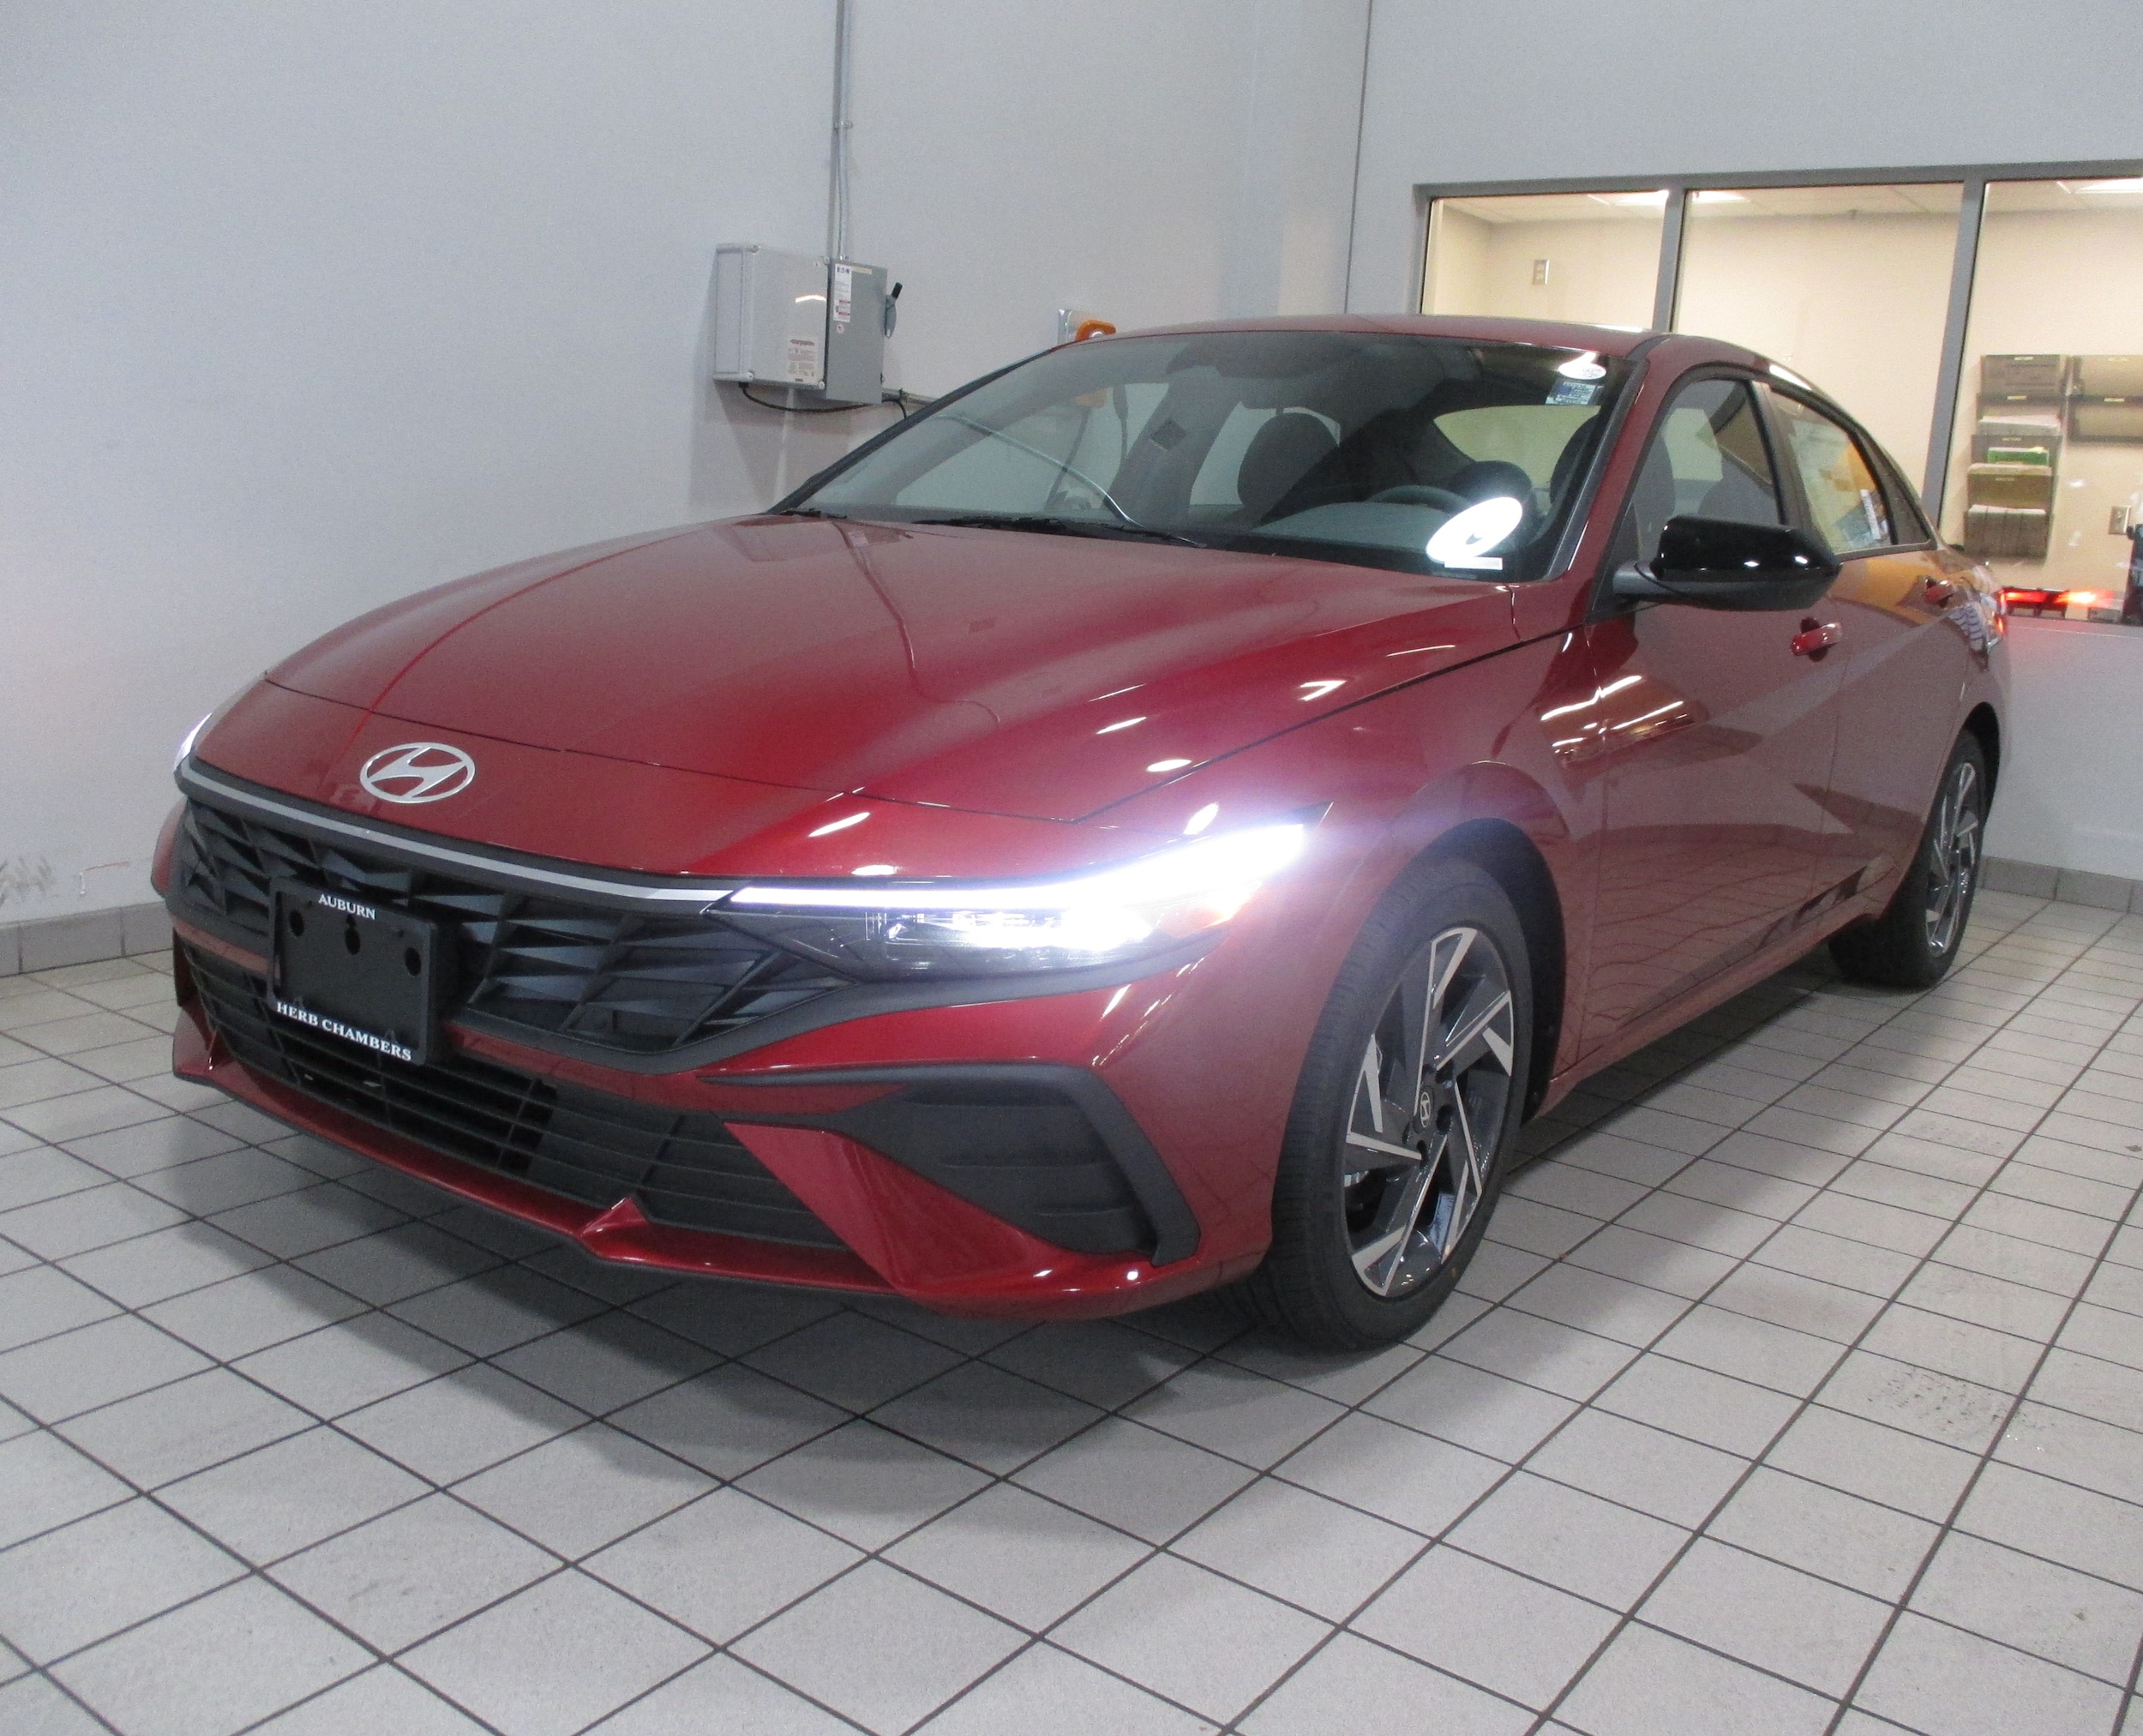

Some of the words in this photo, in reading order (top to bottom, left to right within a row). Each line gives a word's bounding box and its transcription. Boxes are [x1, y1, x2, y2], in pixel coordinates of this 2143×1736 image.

[318, 893, 376, 920] AUBURN
[277, 1001, 319, 1026] HERB
[321, 1018, 412, 1061] CHAMBERS
